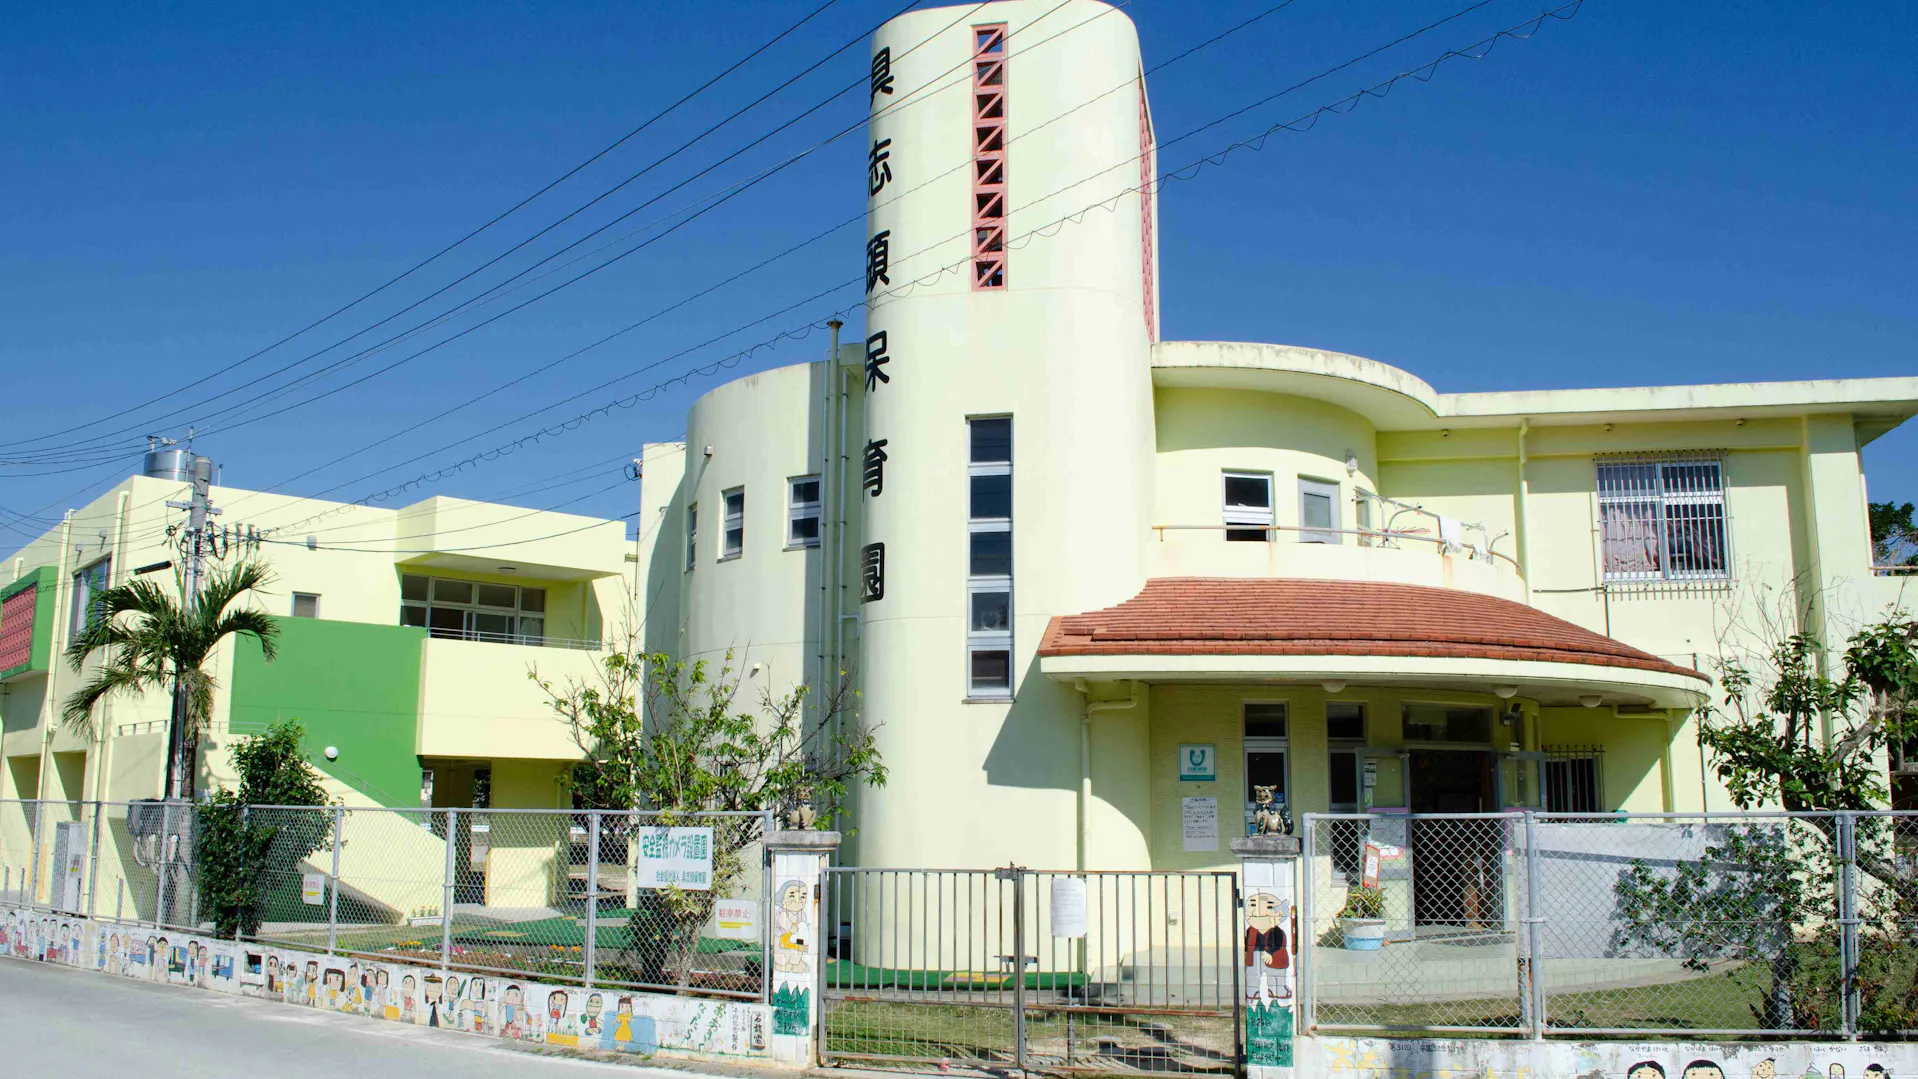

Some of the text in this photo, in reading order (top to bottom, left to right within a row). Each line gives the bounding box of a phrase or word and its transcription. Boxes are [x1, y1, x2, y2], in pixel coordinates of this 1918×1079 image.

[860, 45, 895, 604] 具志頭保育園
[718, 908, 751, 919] 駐車禁止
